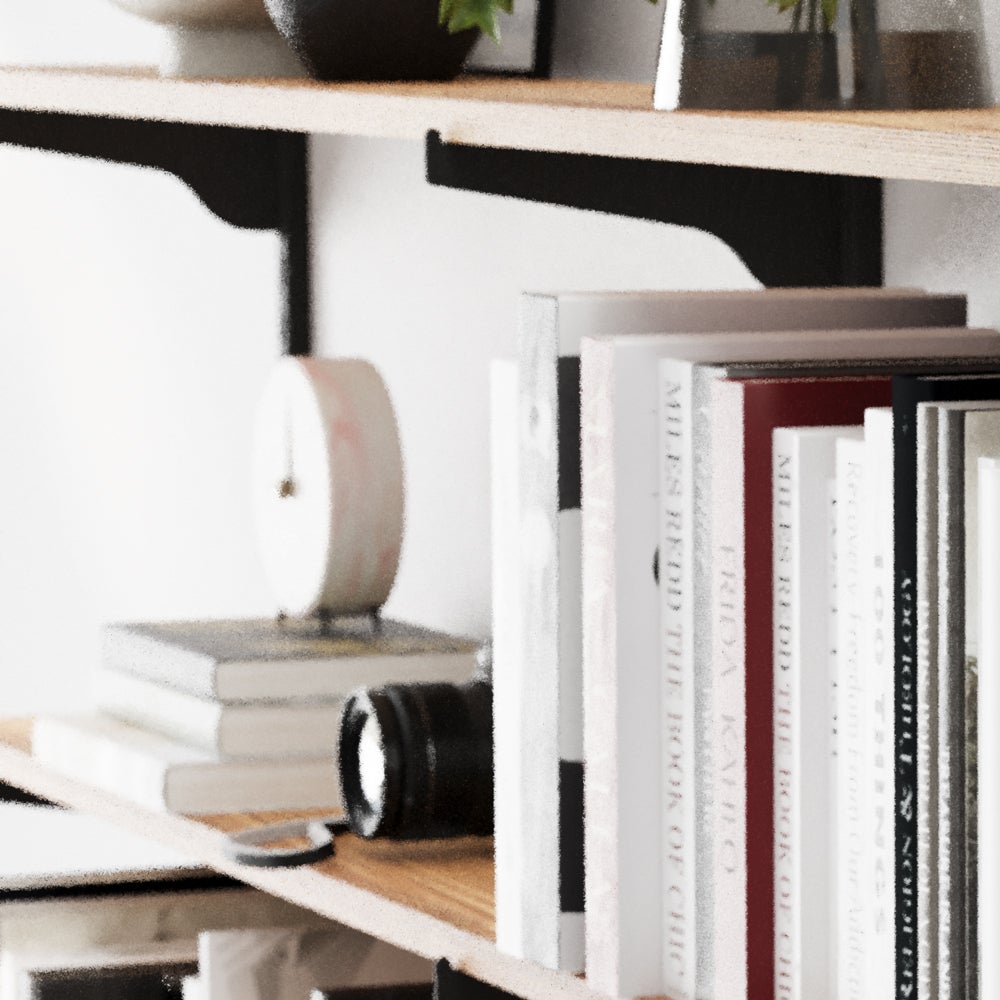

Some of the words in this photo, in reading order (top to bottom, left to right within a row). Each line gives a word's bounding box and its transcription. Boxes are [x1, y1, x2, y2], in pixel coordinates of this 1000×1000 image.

[666, 384, 682, 496] MILES
[778, 455, 791, 562] MILES
[666, 509, 682, 613] REDD
[720, 545, 737, 677] FRIDA
[778, 576, 791, 672] REDD
[667, 625, 683, 697] THE
[667, 712, 684, 811] BOOK
[778, 684, 791, 752] THE
[721, 713, 738, 875] KAHLO
[778, 769, 792, 861] BOOK
[873, 693, 886, 933] THINGS
[900, 787, 913, 823] &
[668, 825, 684, 876] OF
[668, 885, 685, 977] CHIC
[777, 876, 792, 924] OF
